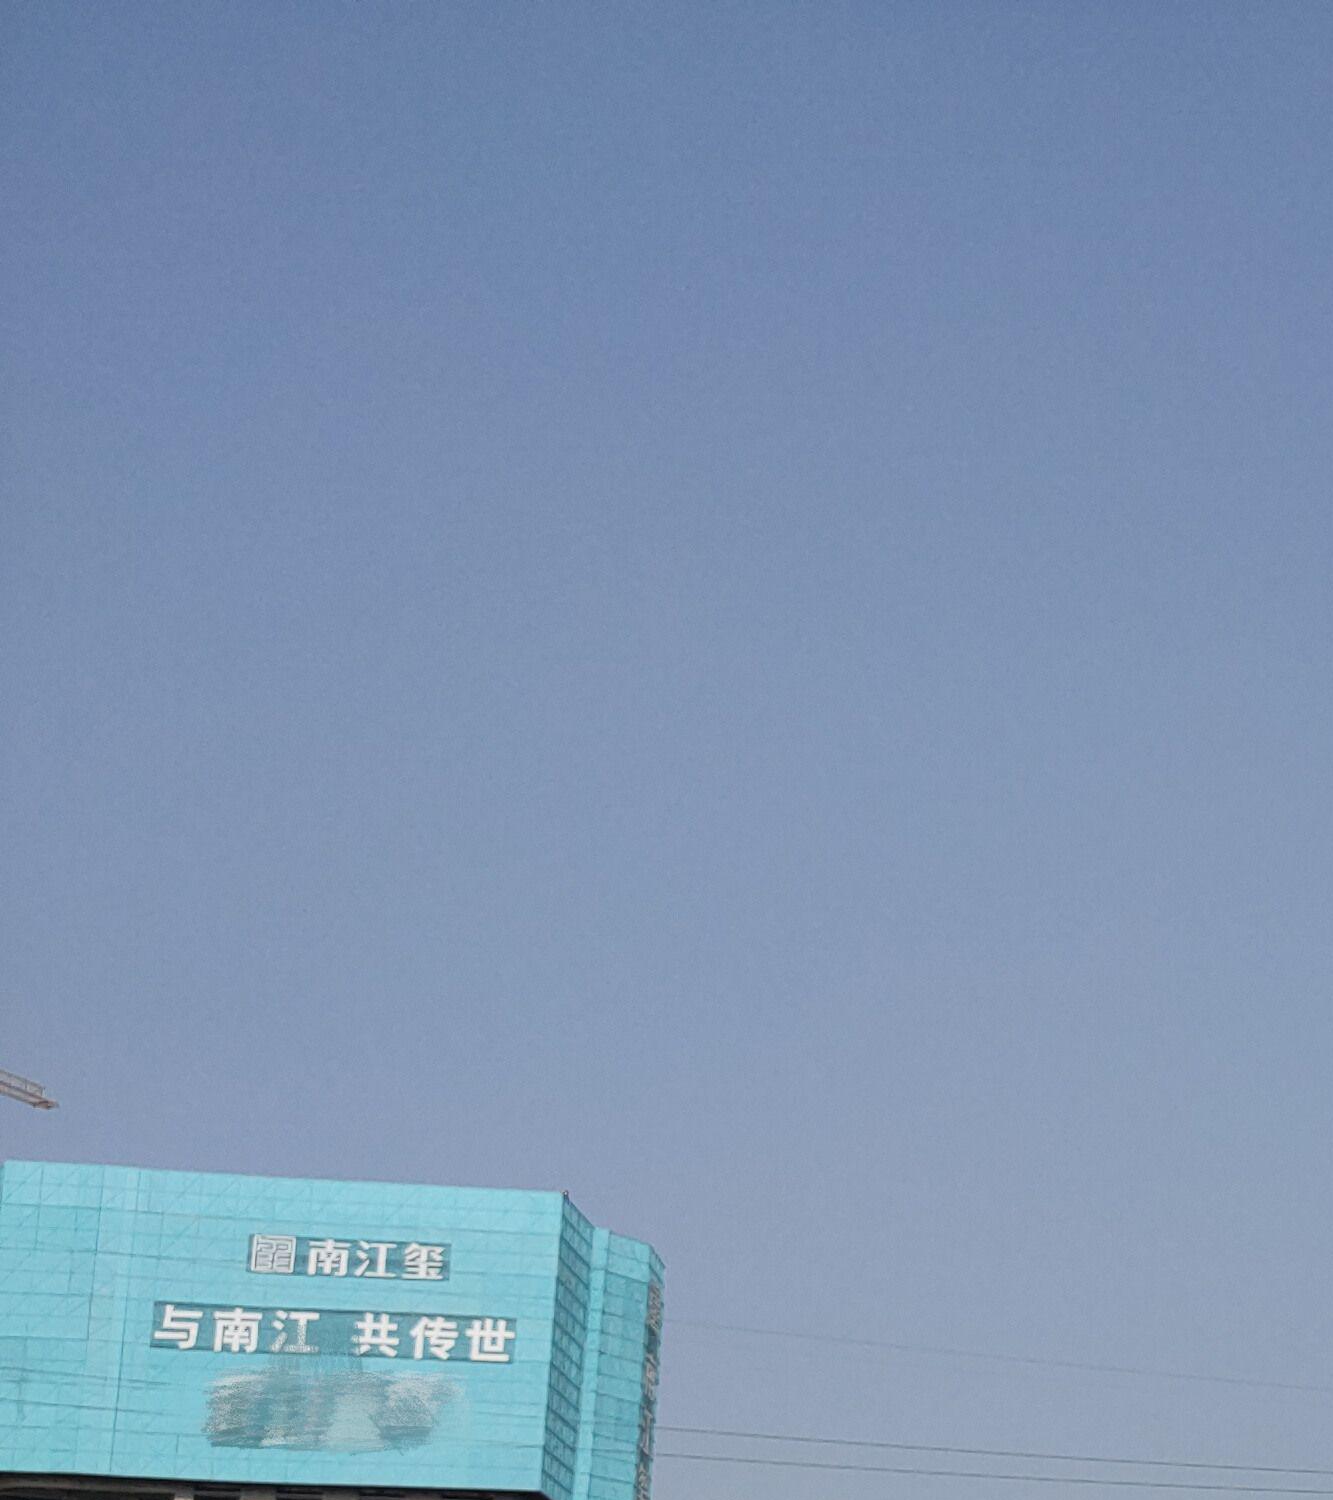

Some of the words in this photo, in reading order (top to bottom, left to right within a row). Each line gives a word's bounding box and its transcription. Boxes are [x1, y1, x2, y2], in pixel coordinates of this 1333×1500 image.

[306, 1237, 447, 1281] 南江玺
[153, 1304, 321, 1354] 与南江
[351, 1311, 516, 1363] 共传世
